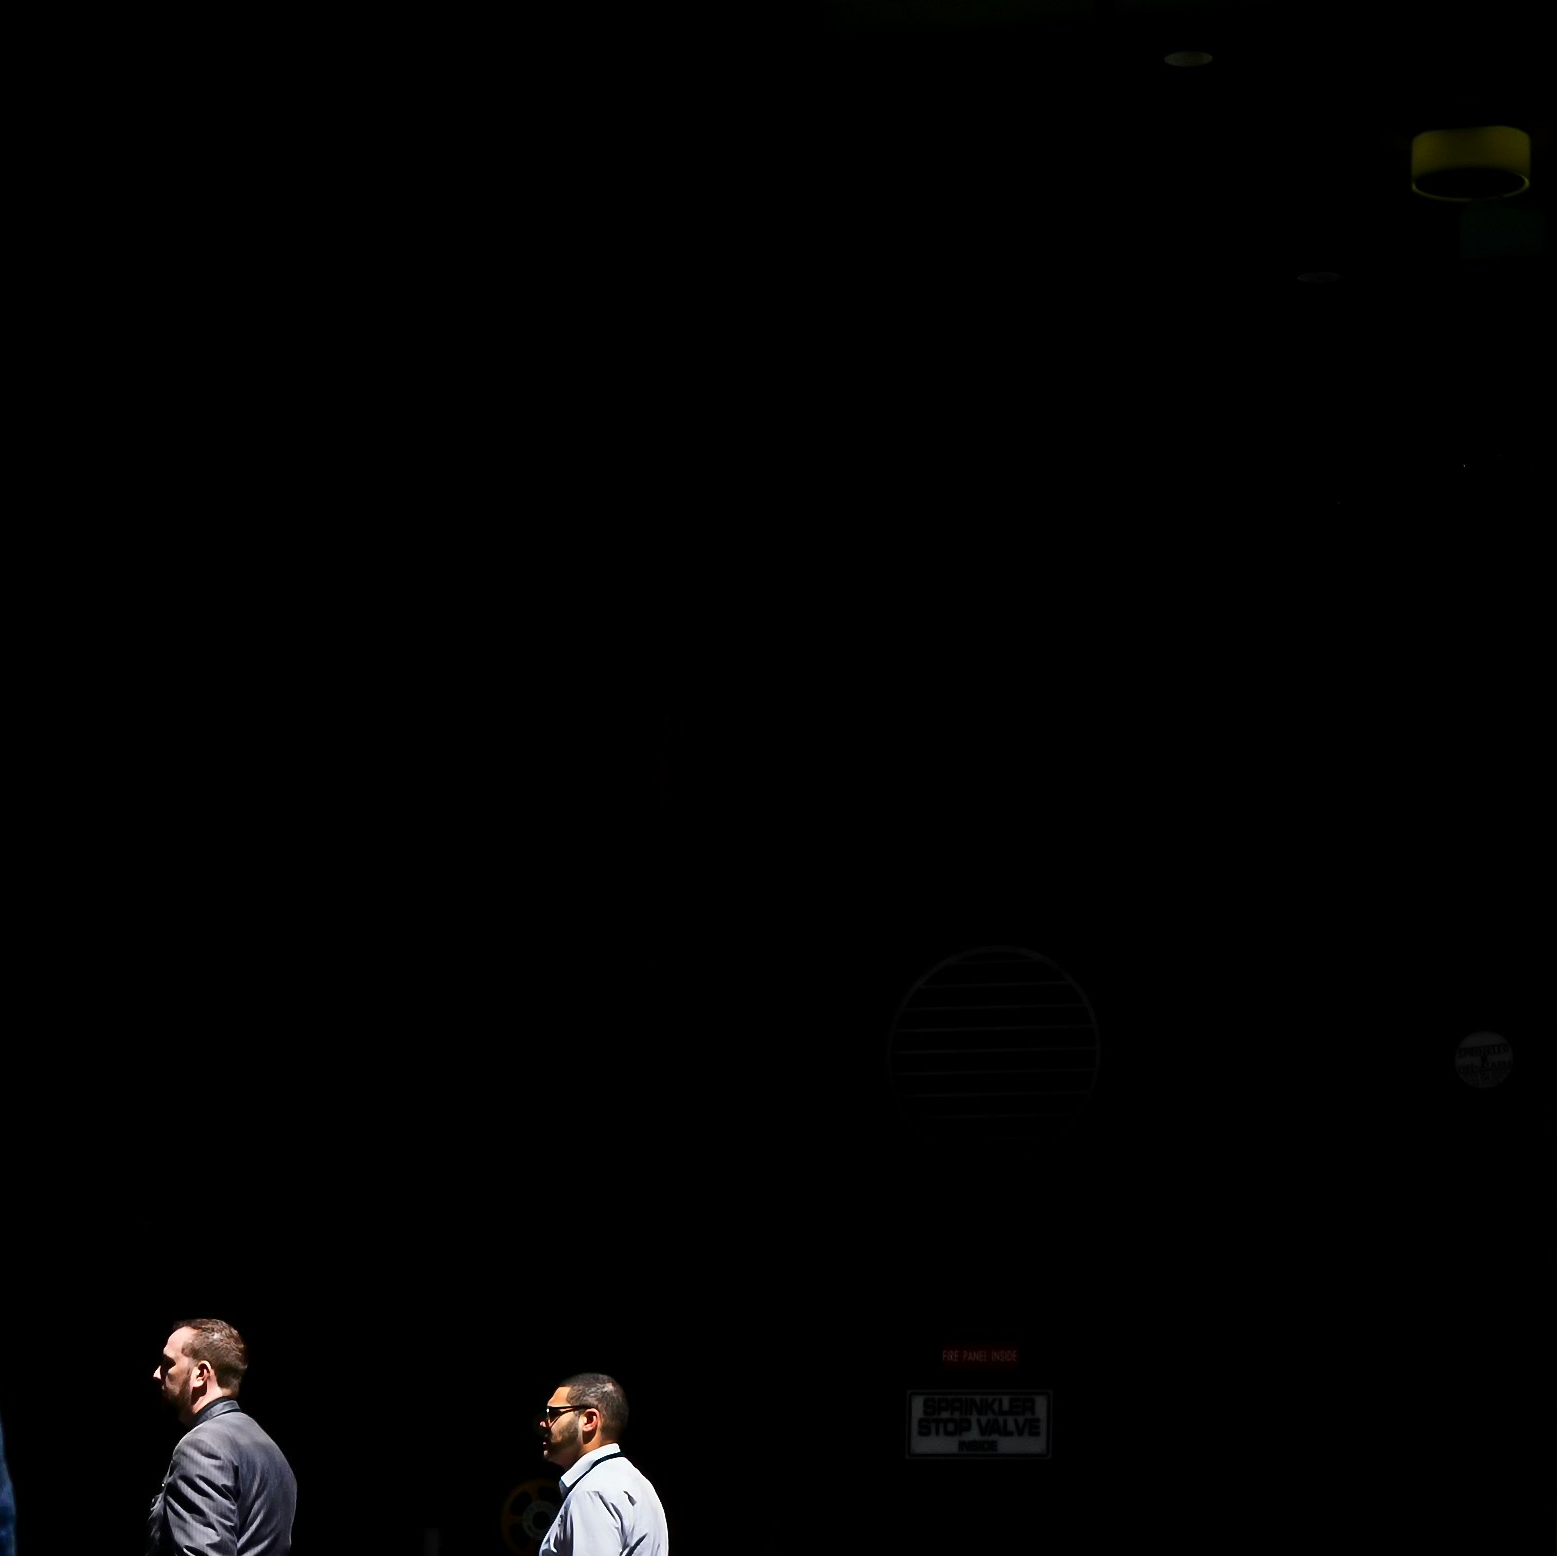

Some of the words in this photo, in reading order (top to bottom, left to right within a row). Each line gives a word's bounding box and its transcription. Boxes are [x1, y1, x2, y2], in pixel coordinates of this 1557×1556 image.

[942, 1349, 960, 1362] FIRE
[962, 1349, 988, 1362] PANEL
[991, 1349, 1018, 1362] INSIDE
[922, 1396, 1036, 1416] SPRINKLER
[917, 1417, 972, 1437] STOP
[976, 1417, 1041, 1437] VALVE
[957, 1439, 999, 1452] INSIDE
